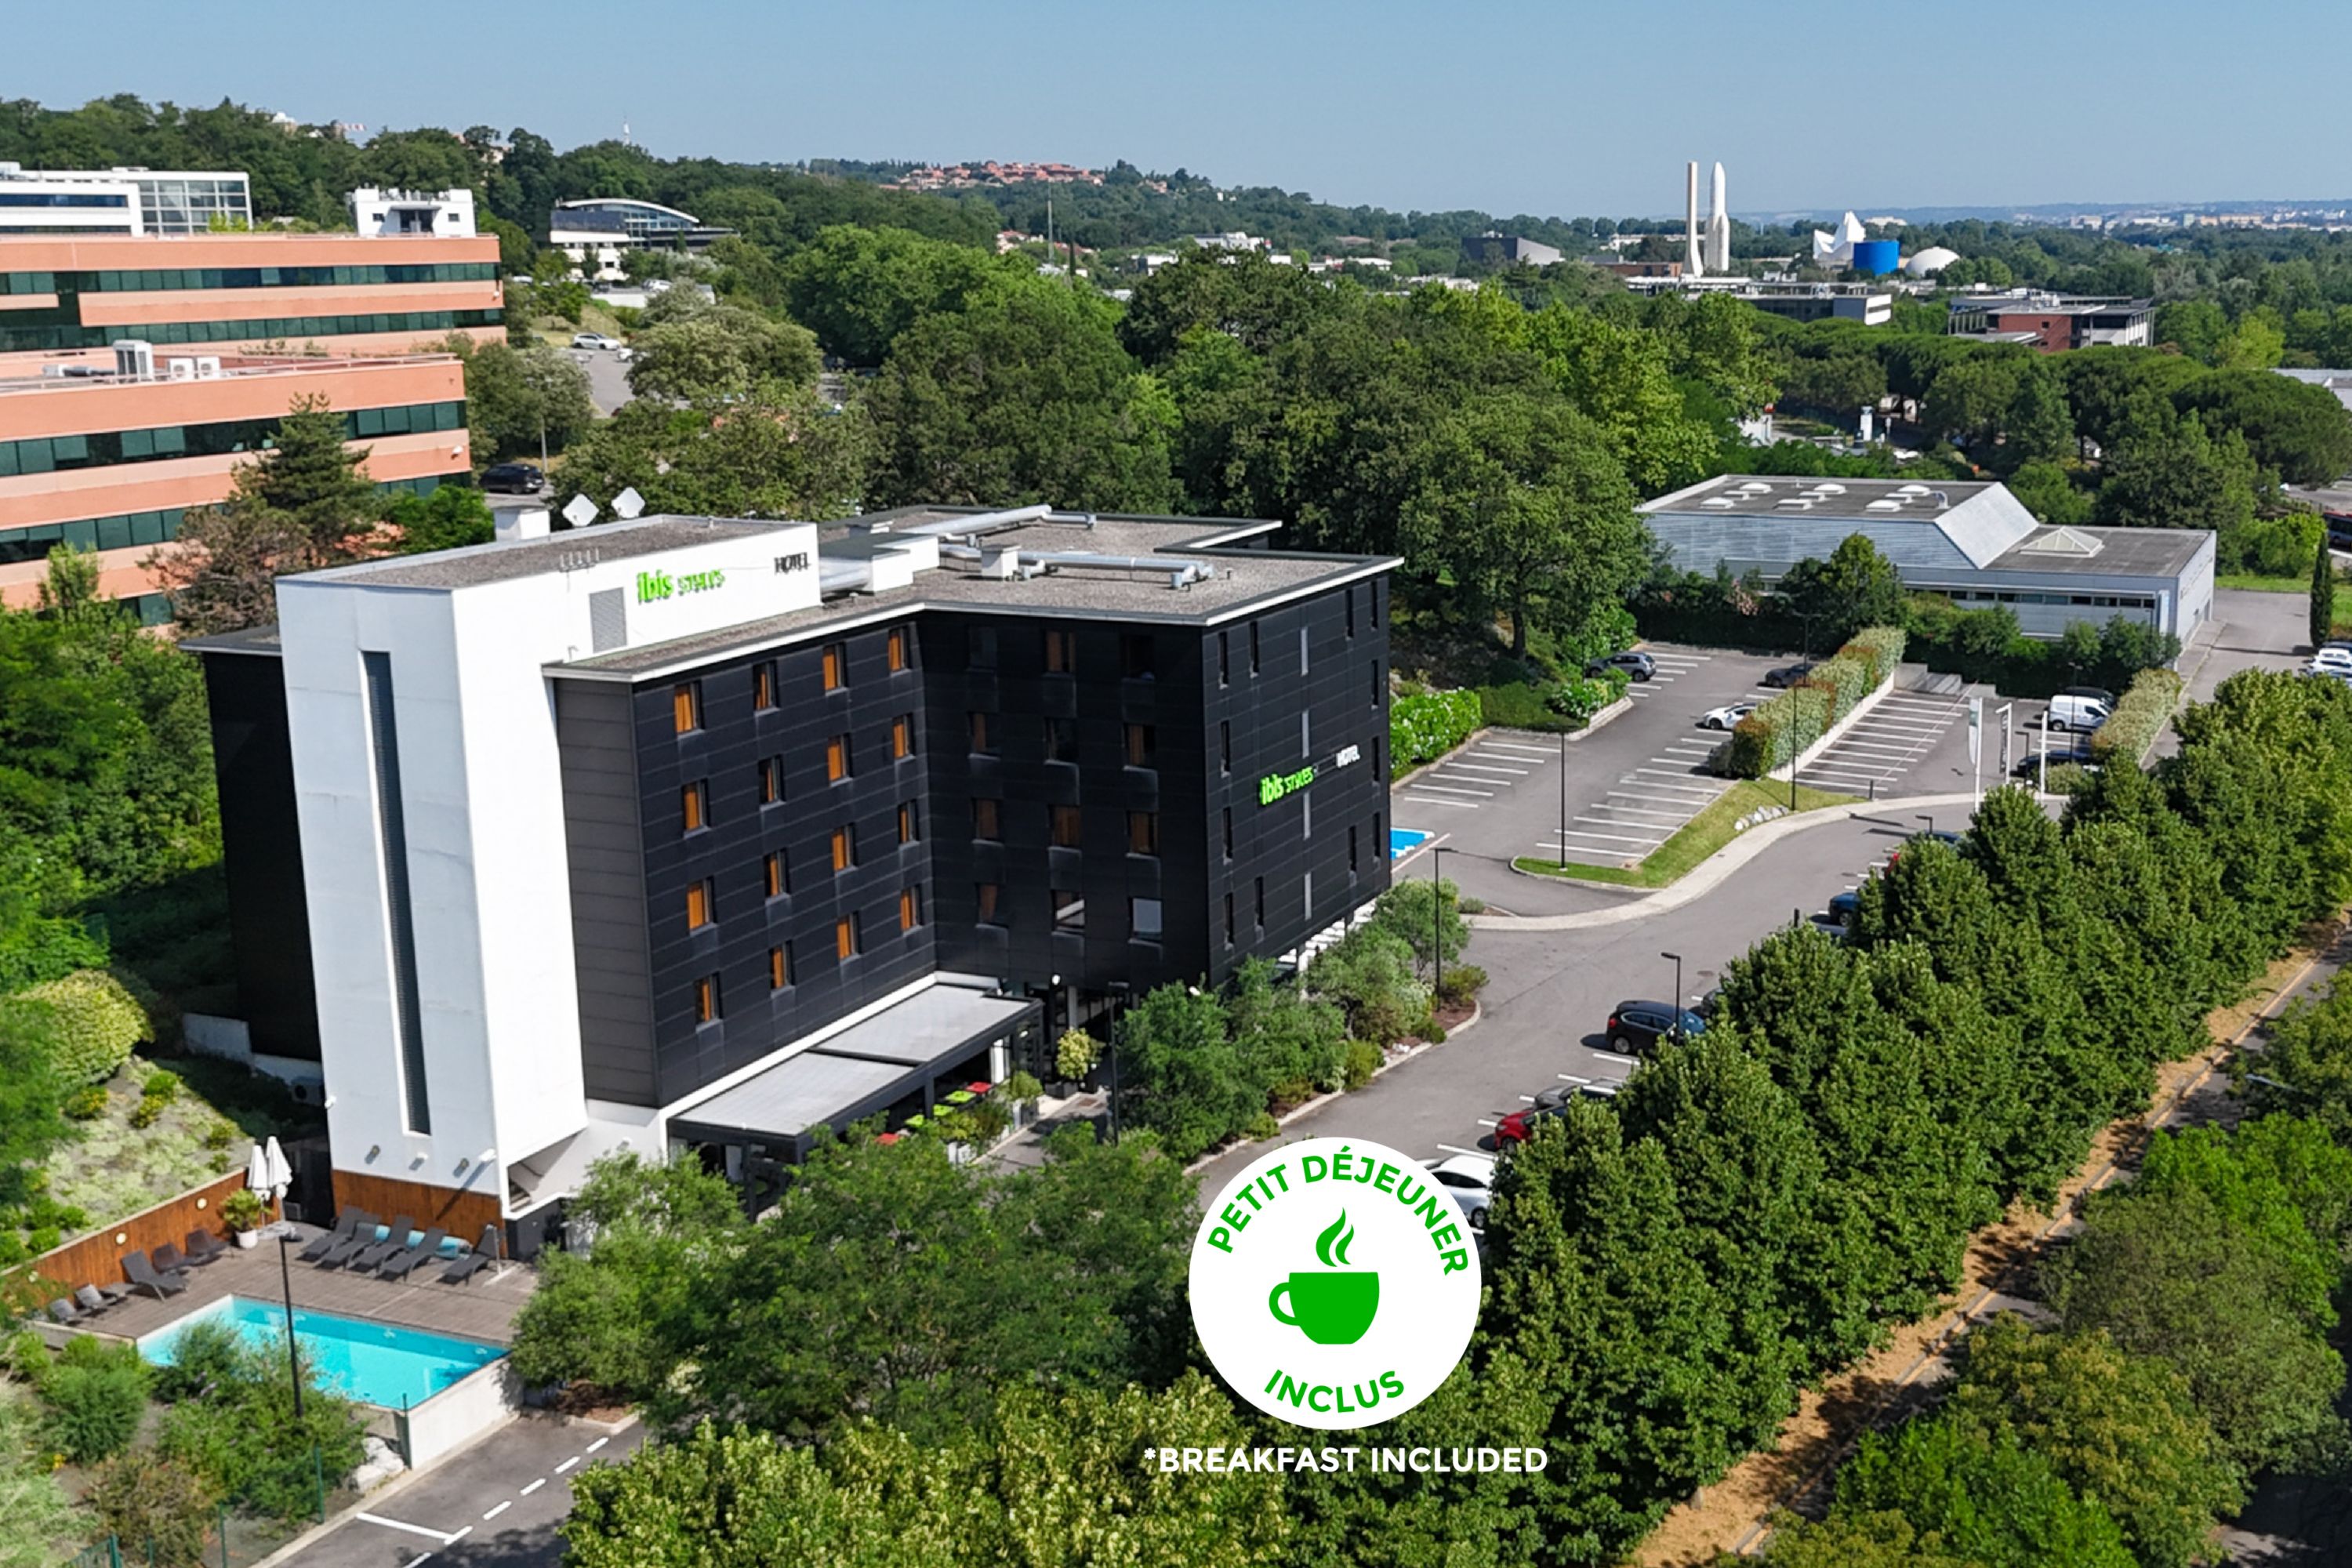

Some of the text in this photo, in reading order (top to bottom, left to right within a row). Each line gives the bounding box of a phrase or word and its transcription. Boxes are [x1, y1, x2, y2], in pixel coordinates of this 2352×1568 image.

[637, 569, 674, 604] ibis
[774, 551, 811, 575] HOTEL
[1260, 774, 1284, 805] ibis
[1336, 745, 1360, 768] HOTEL
